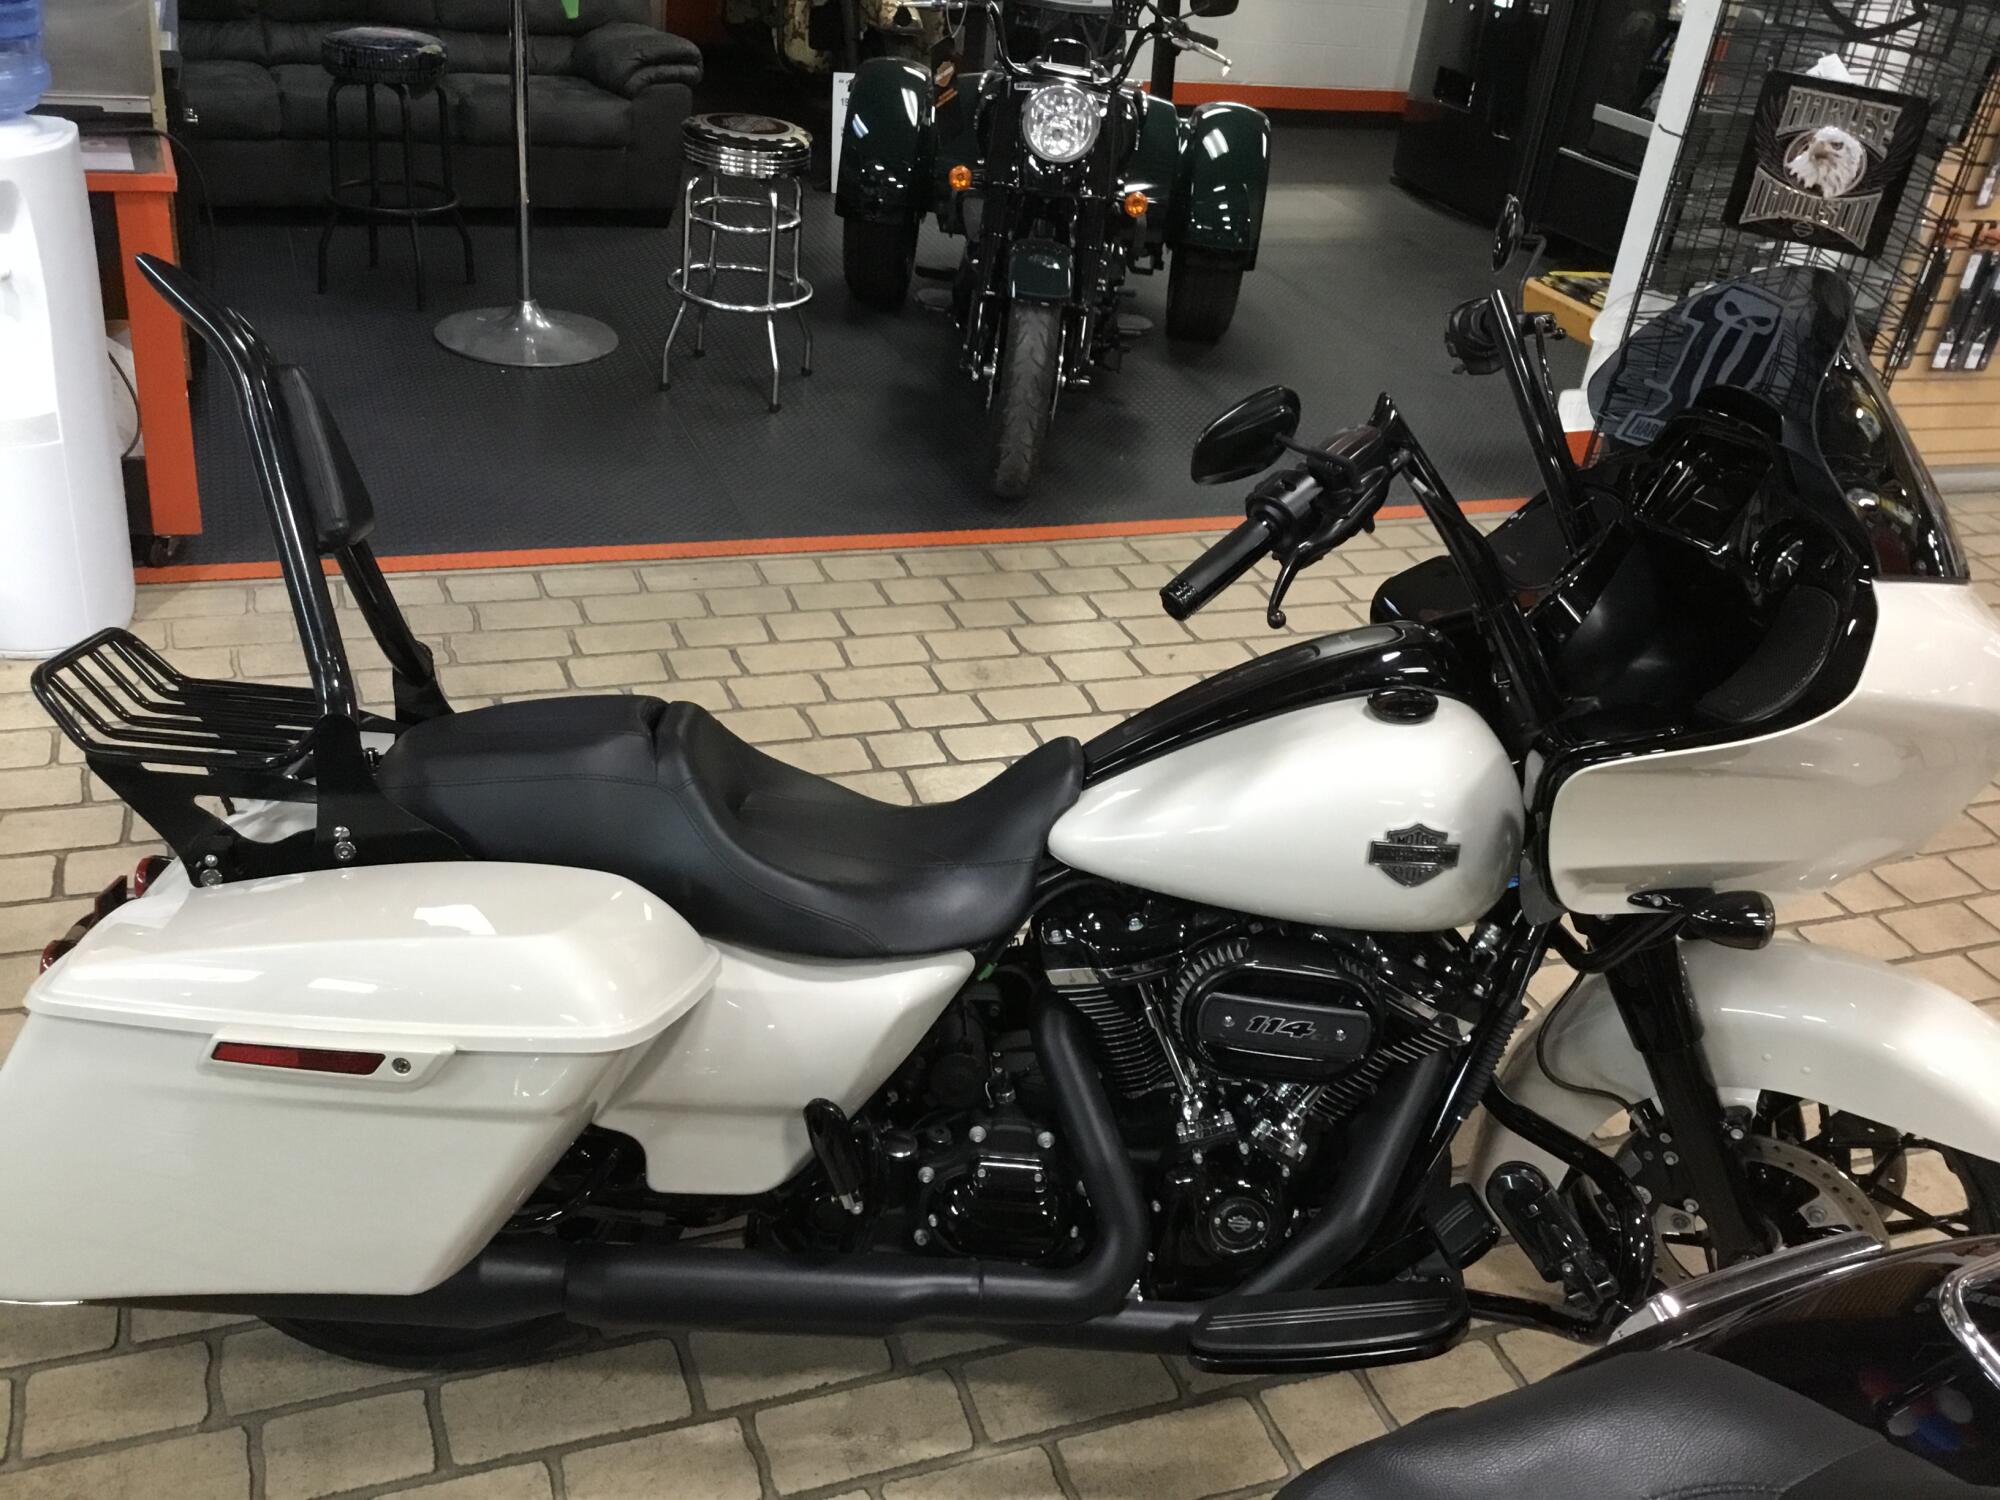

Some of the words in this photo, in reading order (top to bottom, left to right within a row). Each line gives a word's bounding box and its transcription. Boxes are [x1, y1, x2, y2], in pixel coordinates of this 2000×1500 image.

[1777, 86, 1903, 162] HARLEY
[1739, 165, 1884, 252] DAVIDSON
[1245, 1015, 1317, 1038] 114
